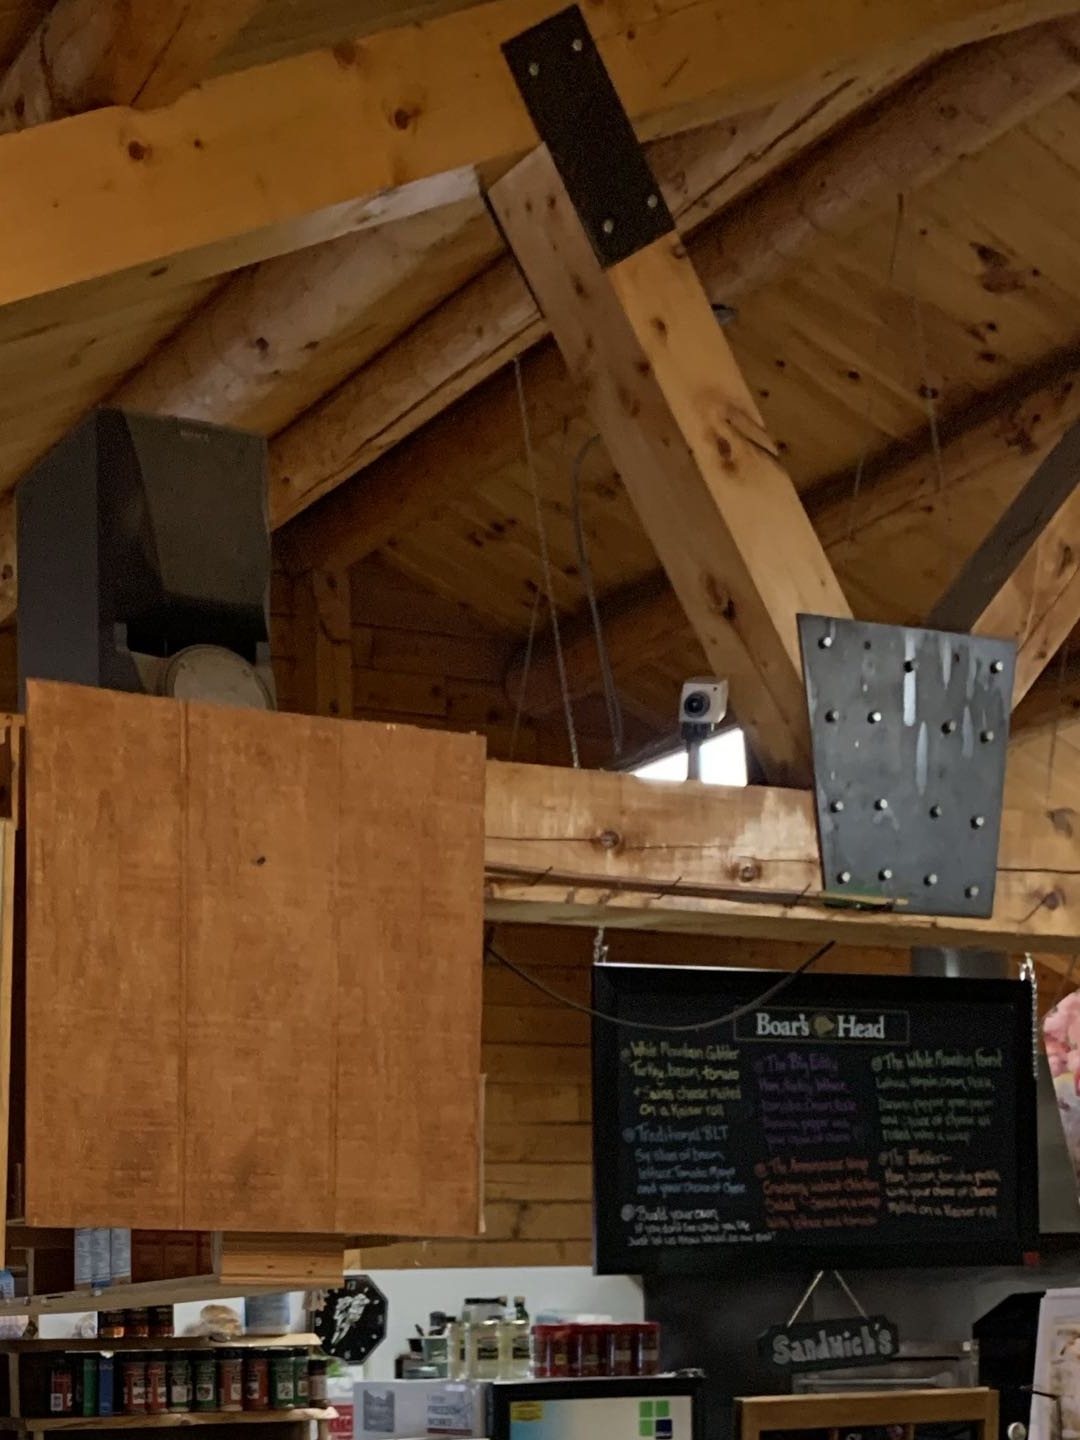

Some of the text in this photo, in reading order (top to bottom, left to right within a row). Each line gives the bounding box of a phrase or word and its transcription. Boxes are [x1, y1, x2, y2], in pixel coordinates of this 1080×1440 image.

[756, 1012, 886, 1039] Boar's Head
[773, 1322, 892, 1365] Sandwich's
